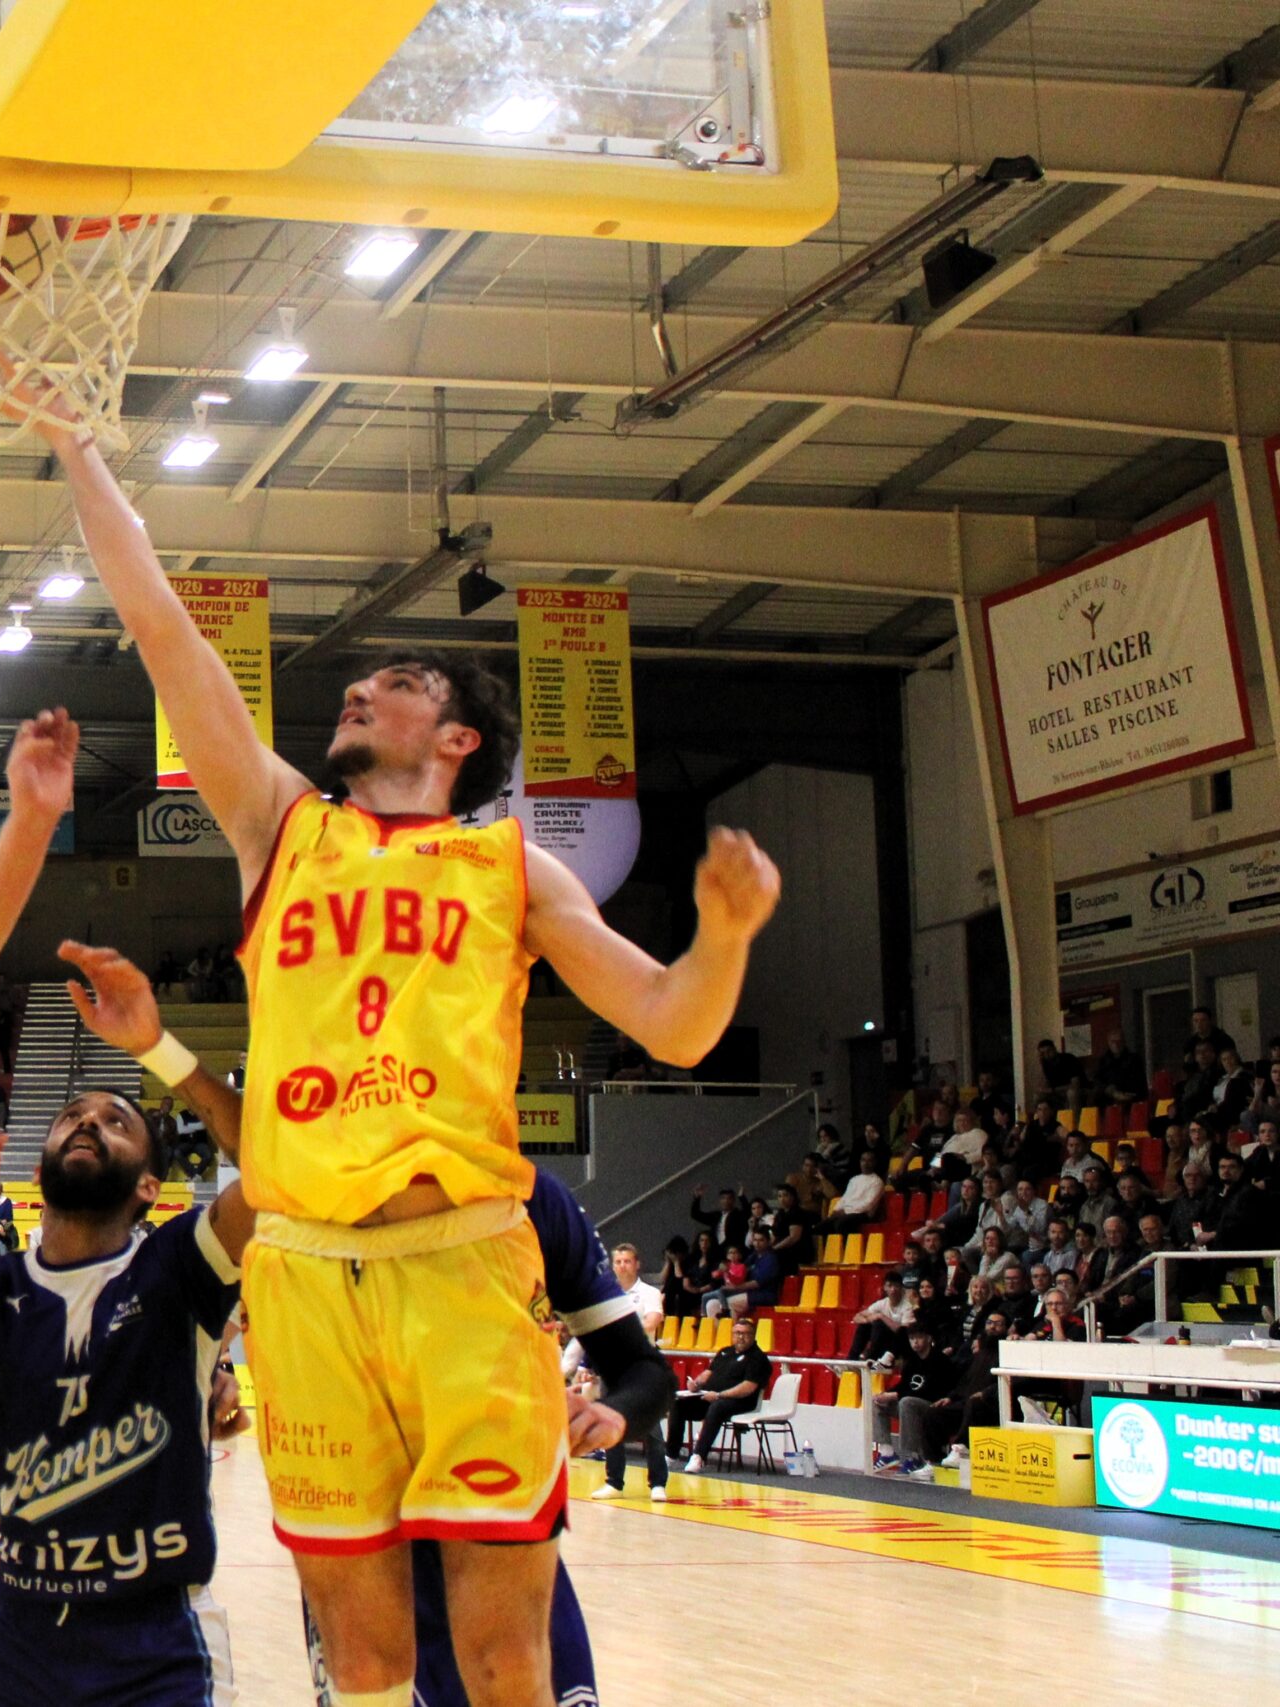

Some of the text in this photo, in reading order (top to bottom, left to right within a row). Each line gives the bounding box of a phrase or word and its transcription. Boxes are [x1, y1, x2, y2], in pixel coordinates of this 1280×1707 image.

[171, 581, 258, 597] 020 2021
[525, 591, 620, 609] 2023 2024
[234, 602, 249, 612] DE
[561, 641, 596, 652] POULE
[1047, 630, 1152, 692] FONTAGER
[1028, 665, 1194, 736] HOTEL RESTAURANT
[1047, 699, 1178, 755] SALLES PISCINE
[1075, 891, 1119, 910] Groupama
[277, 888, 469, 969] SVBD
[356, 974, 389, 1037] 8
[56, 1374, 91, 1427] 75
[271, 1417, 327, 1439] SAINT
[1175, 1413, 1255, 1441] Dunker
[271, 1435, 352, 1458] VALLIER
[1112, 1458, 1153, 1474] ECOVIA
[3, 1574, 108, 1593] mutuelle
